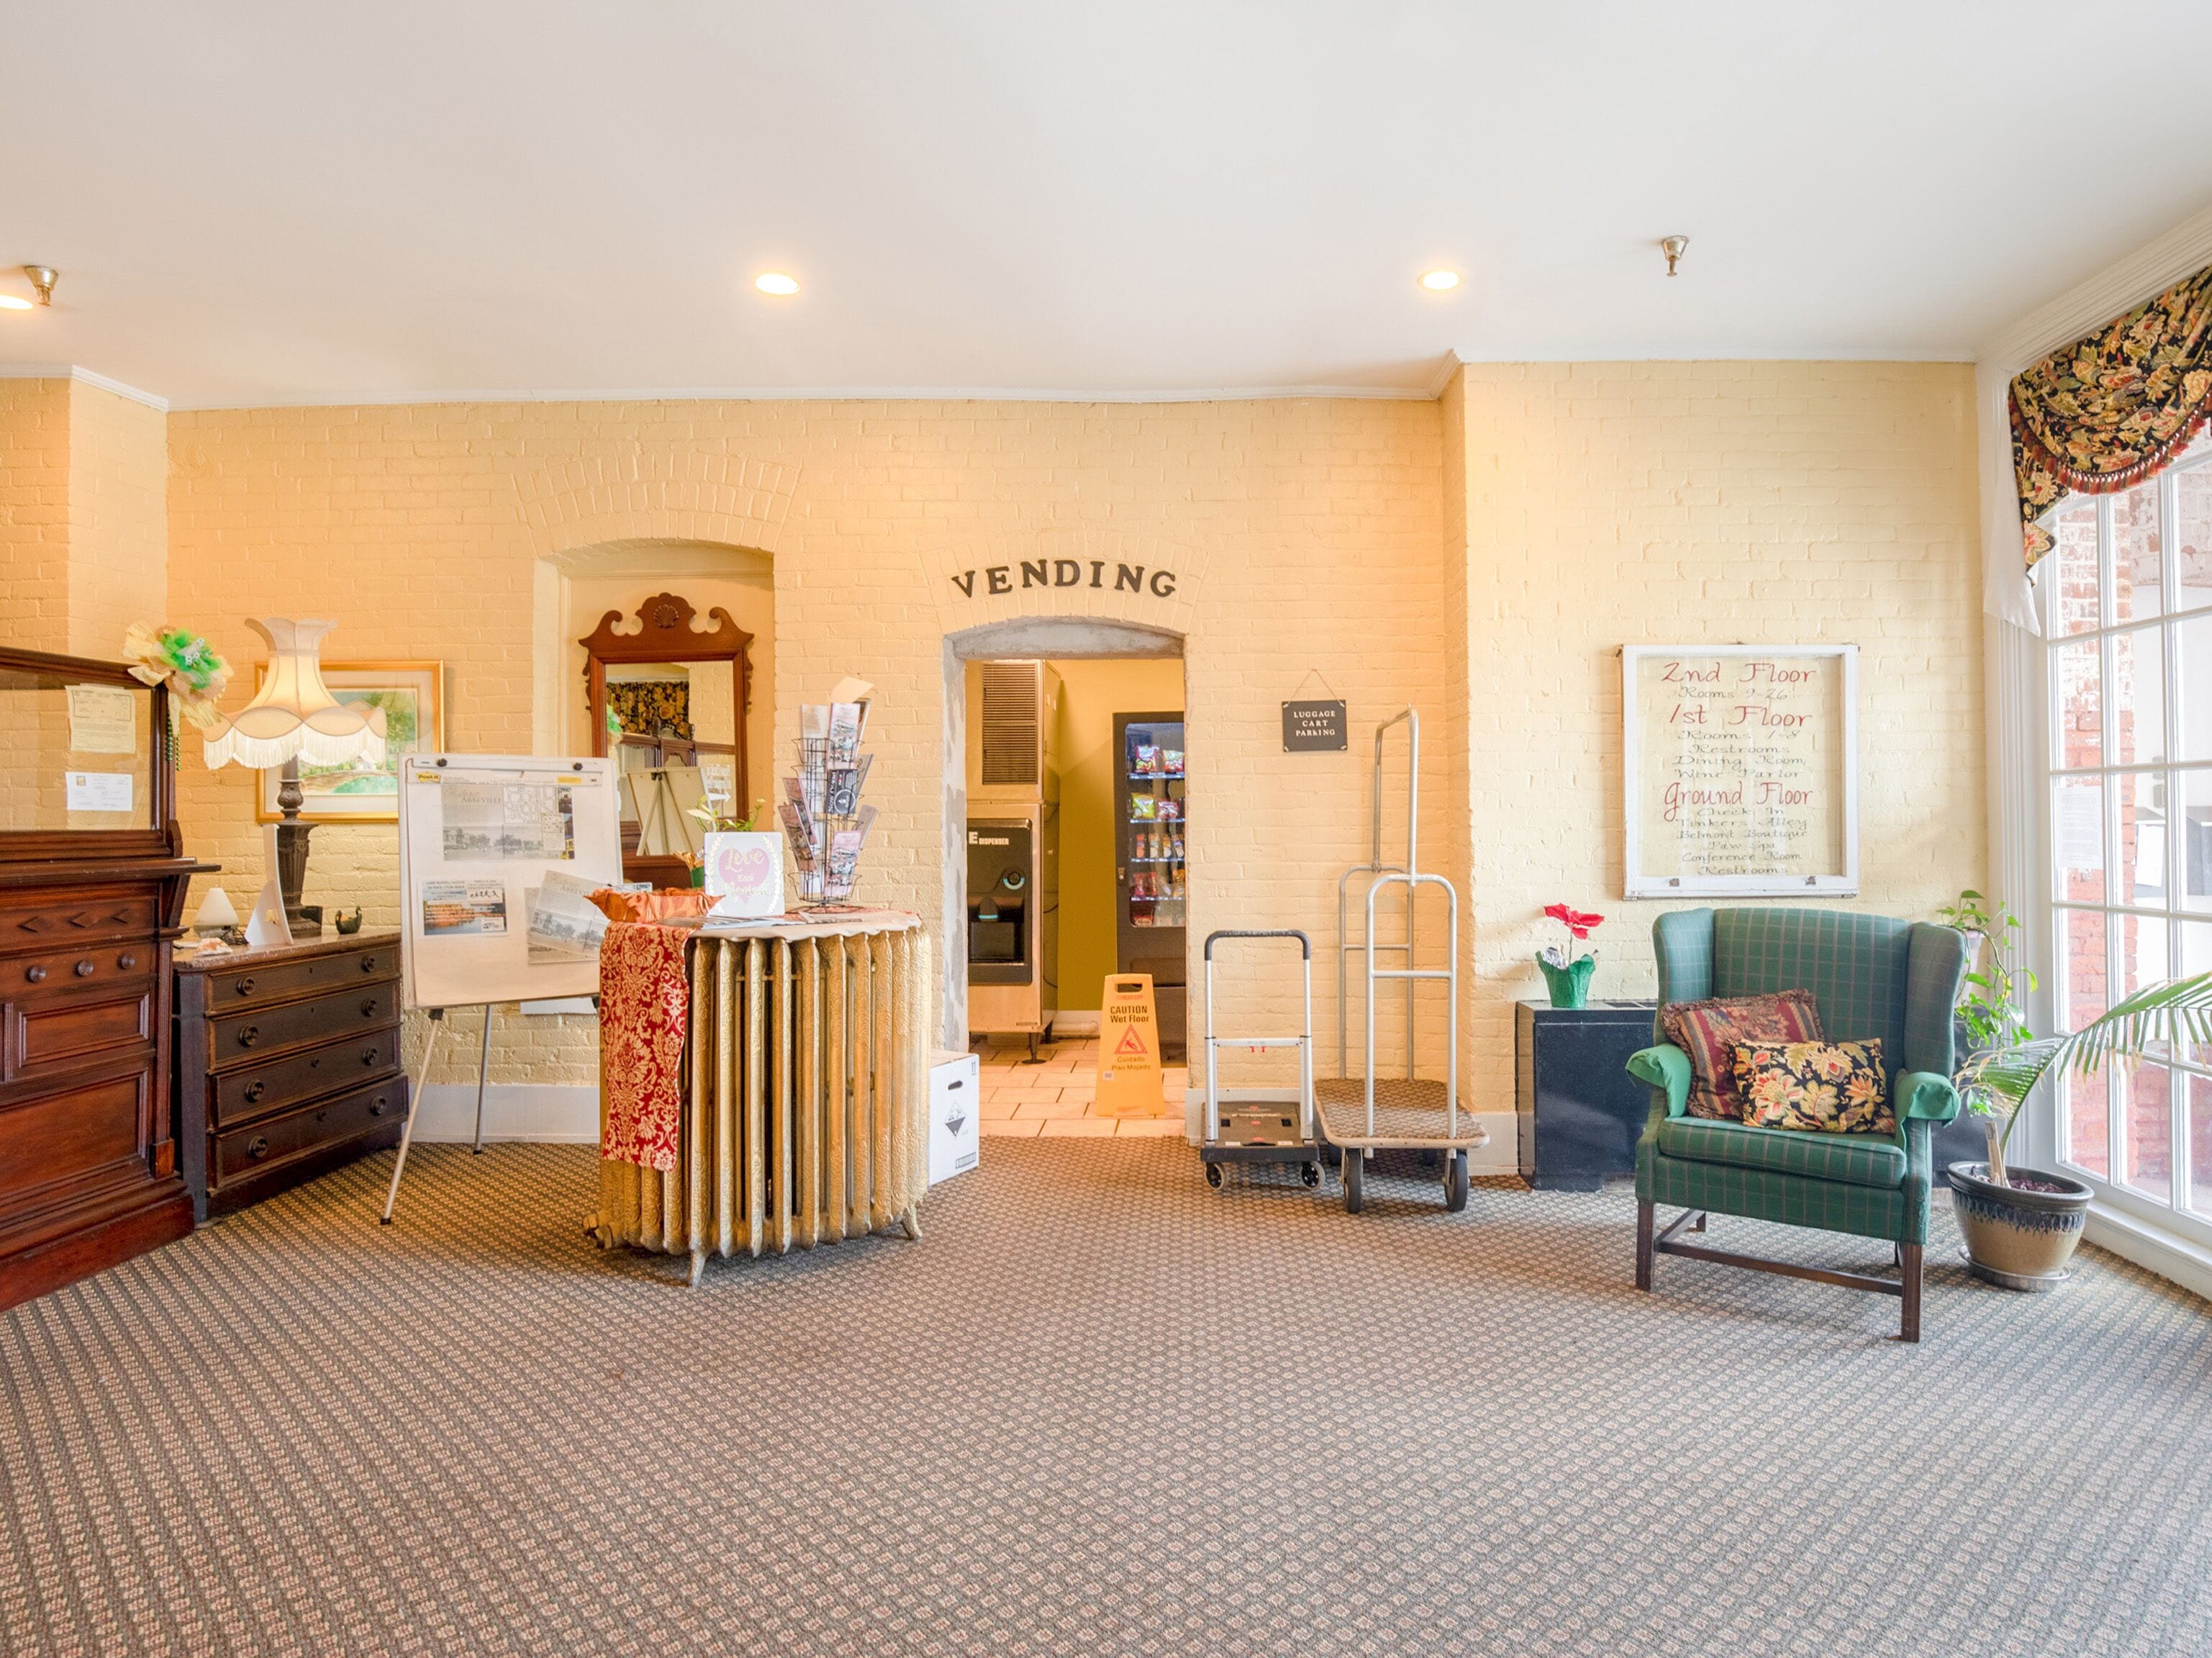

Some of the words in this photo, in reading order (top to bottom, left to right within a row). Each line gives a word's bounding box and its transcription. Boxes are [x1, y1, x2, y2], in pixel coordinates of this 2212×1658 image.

[951, 558, 1176, 598] VENDING
[1661, 661, 1721, 682] 2nd
[1739, 663, 1816, 683] Floor
[1677, 686, 1734, 698] Rooms
[1746, 688, 1787, 700] 9-26
[1669, 704, 1708, 724] 1st
[1728, 706, 1813, 727] Floor
[1295, 728, 1336, 737] PARKING
[1677, 730, 1751, 740] Rooms
[1688, 744, 1790, 754] Restrooms
[1672, 755, 1742, 771] Dining
[1674, 769, 1724, 779] Wine
[1737, 768, 1804, 778] Parlor
[1664, 781, 1742, 822] Ground
[1756, 782, 1813, 805] Floor
[1697, 807, 1752, 817] Check
[1758, 817, 1808, 830] Alley
[1676, 830, 1734, 839] Belmont
[1744, 830, 1808, 841] Boutique
[1749, 841, 1776, 852] Spa
[725, 845, 765, 872] Love
[1682, 852, 1756, 864] Conference
[1764, 851, 1803, 861] Room
[1697, 865, 1788, 875] Restrooms
[1110, 1005, 1148, 1015] CAUTION
[1129, 1014, 1149, 1023] Floor
